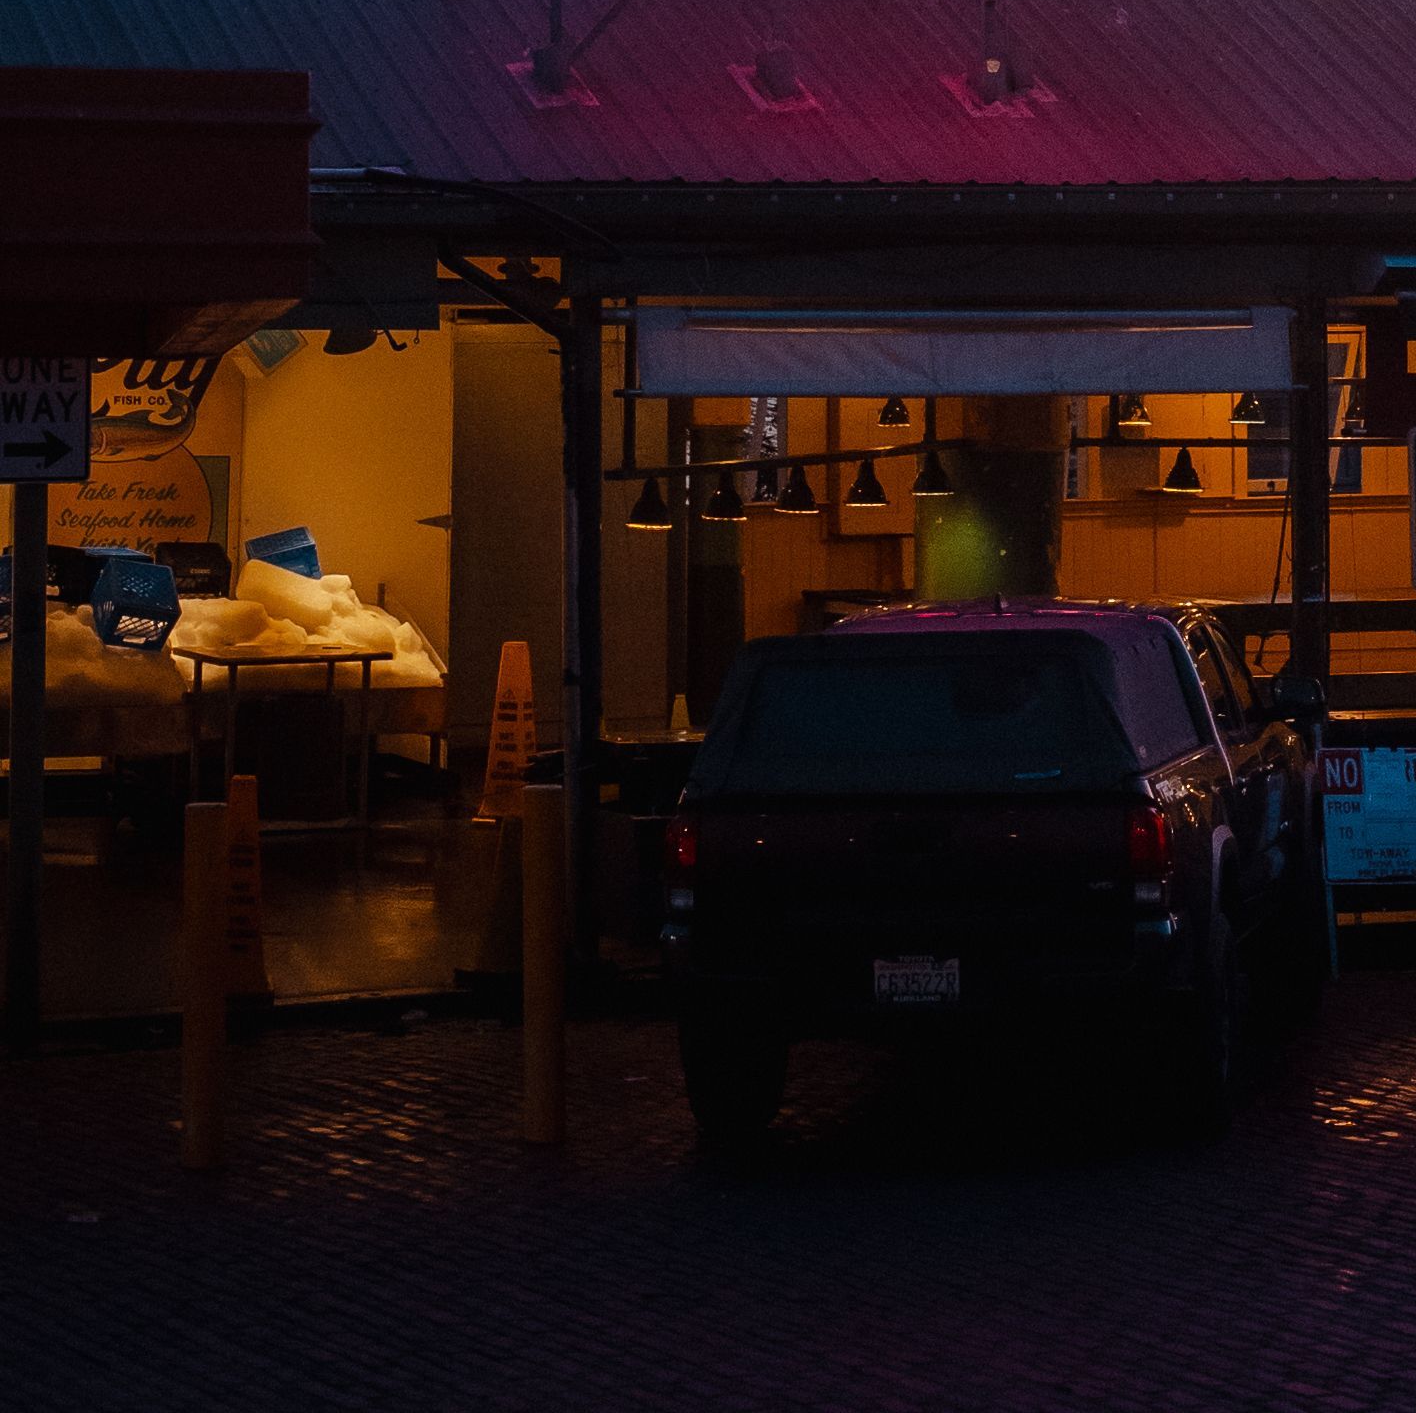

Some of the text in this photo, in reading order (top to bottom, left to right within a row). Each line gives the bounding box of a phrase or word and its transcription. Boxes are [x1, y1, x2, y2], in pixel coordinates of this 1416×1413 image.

[3, 356, 77, 384] ONE
[1, 391, 79, 423] WAY
[113, 395, 142, 406] FISH
[77, 480, 180, 502] Take Fresh
[56, 507, 197, 536] Seafood Home
[1324, 756, 1360, 789] NO
[1327, 800, 1361, 814] FROM
[1339, 827, 1354, 840] TO
